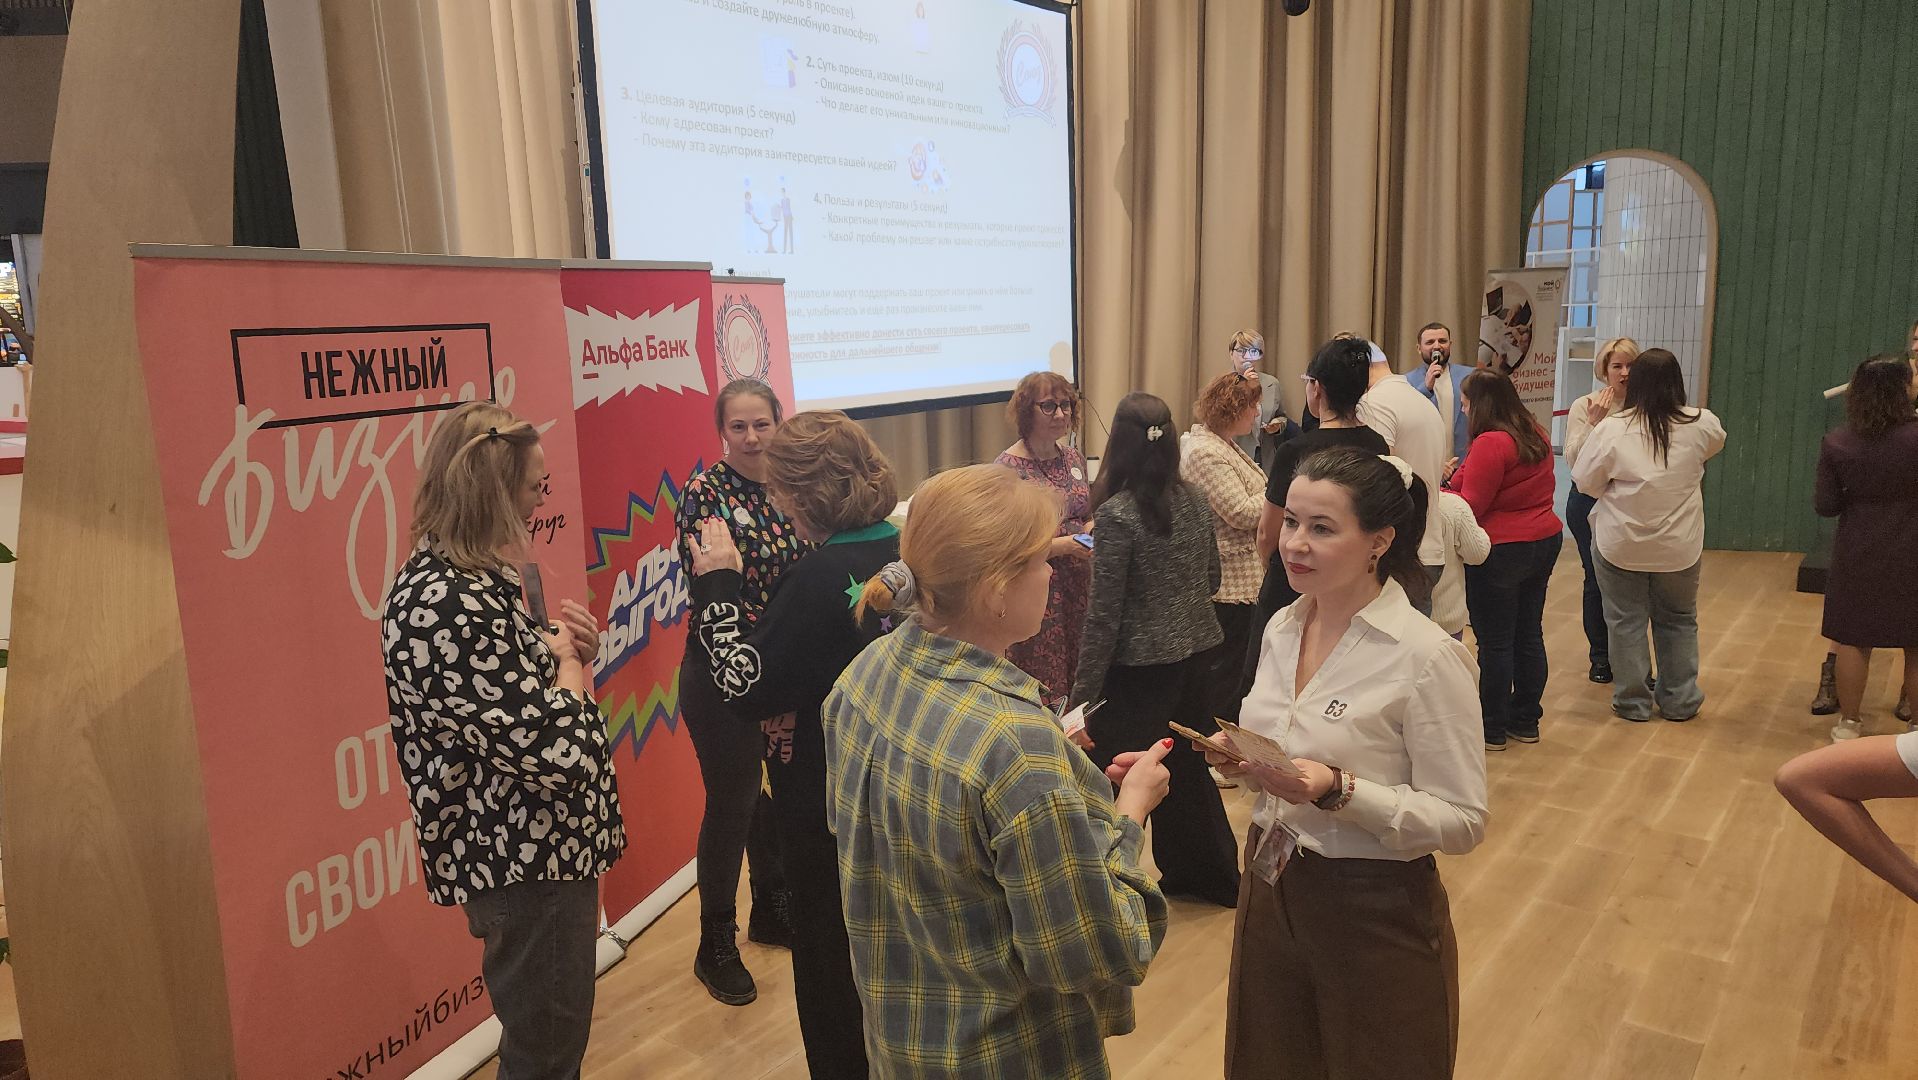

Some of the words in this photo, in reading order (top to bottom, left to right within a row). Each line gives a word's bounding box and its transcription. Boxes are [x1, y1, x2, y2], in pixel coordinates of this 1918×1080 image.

[817, 57, 837, 73] Суть
[820, 77, 864, 96] Описание
[635, 89, 685, 108] Целевая
[688, 98, 744, 117] аудитория
[820, 97, 837, 110] Что
[642, 132, 687, 152] Почему
[708, 143, 763, 159] аудитория
[581, 336, 644, 371] Альфа
[645, 334, 691, 361] Банк
[1534, 352, 1556, 365] Мой
[301, 337, 448, 399] НЕЖНЫЙ
[1512, 379, 1555, 394] будущее
[325, 975, 485, 1080] жныйбиз
